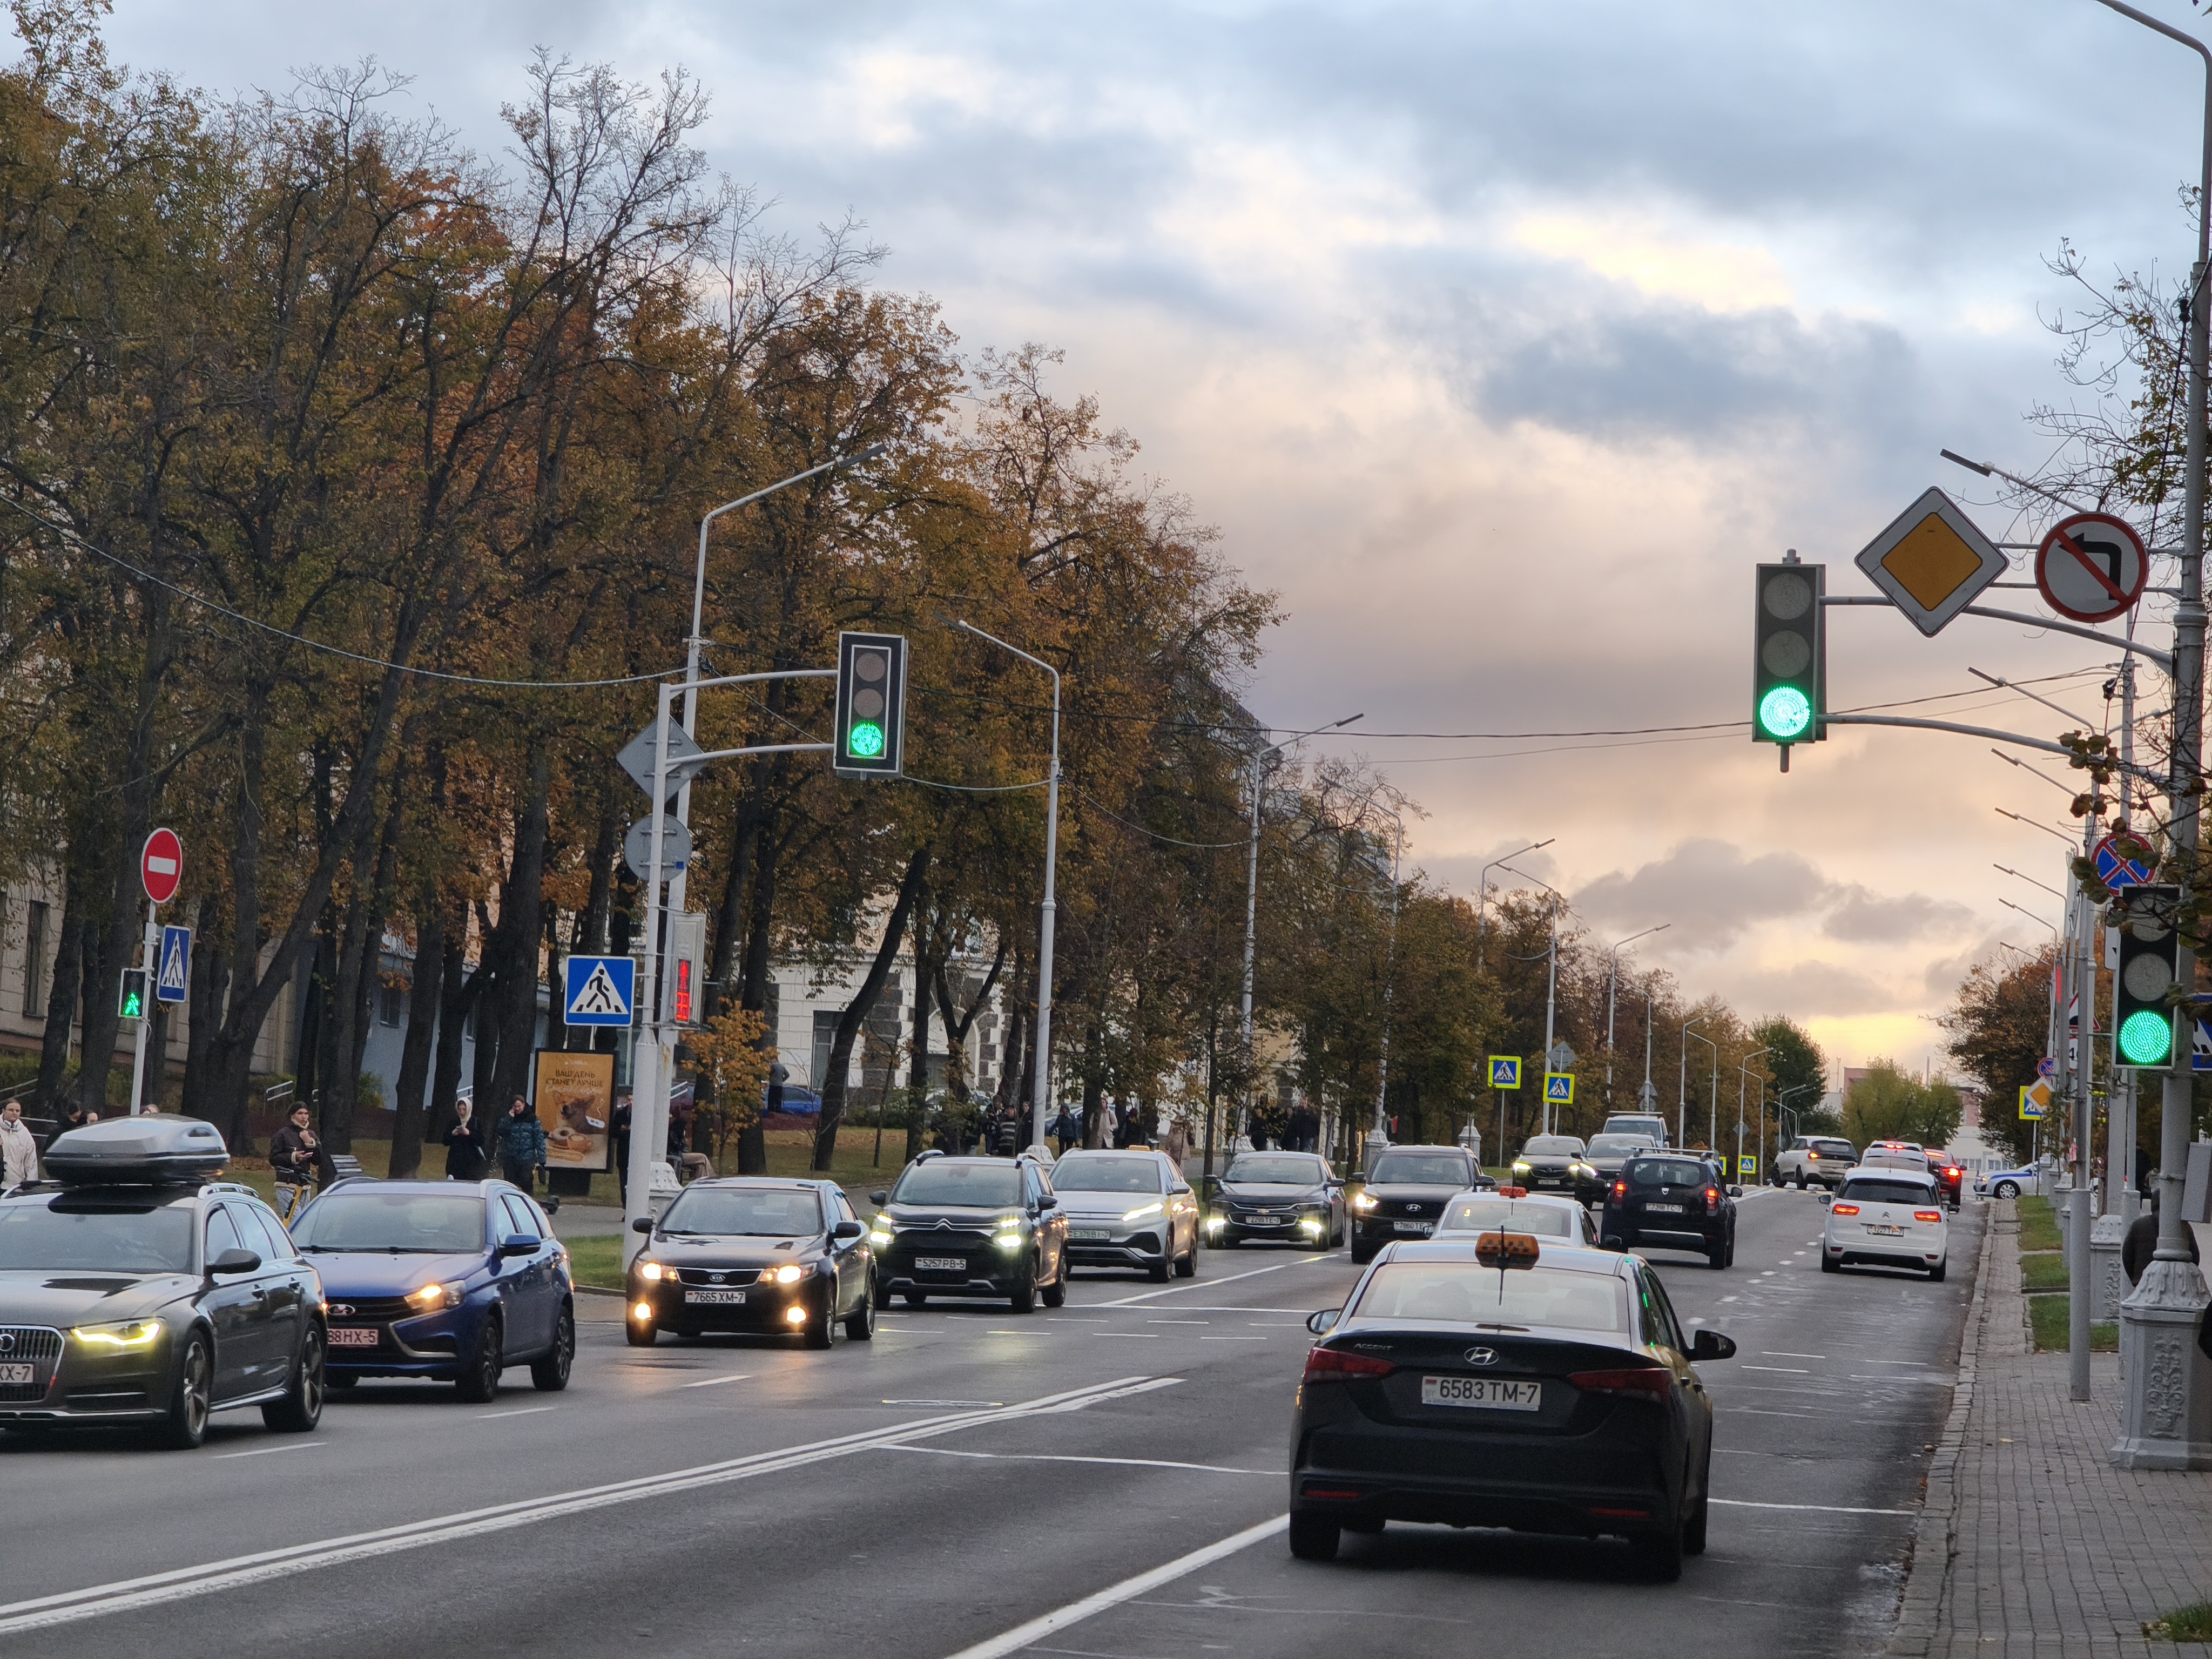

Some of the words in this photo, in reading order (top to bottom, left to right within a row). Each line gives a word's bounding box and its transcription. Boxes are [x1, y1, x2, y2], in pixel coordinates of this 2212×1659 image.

[719, 1293, 744, 1303] XM-7
[1440, 1379, 1484, 1400] 6583
[1489, 1382, 1538, 1404] TM-7
